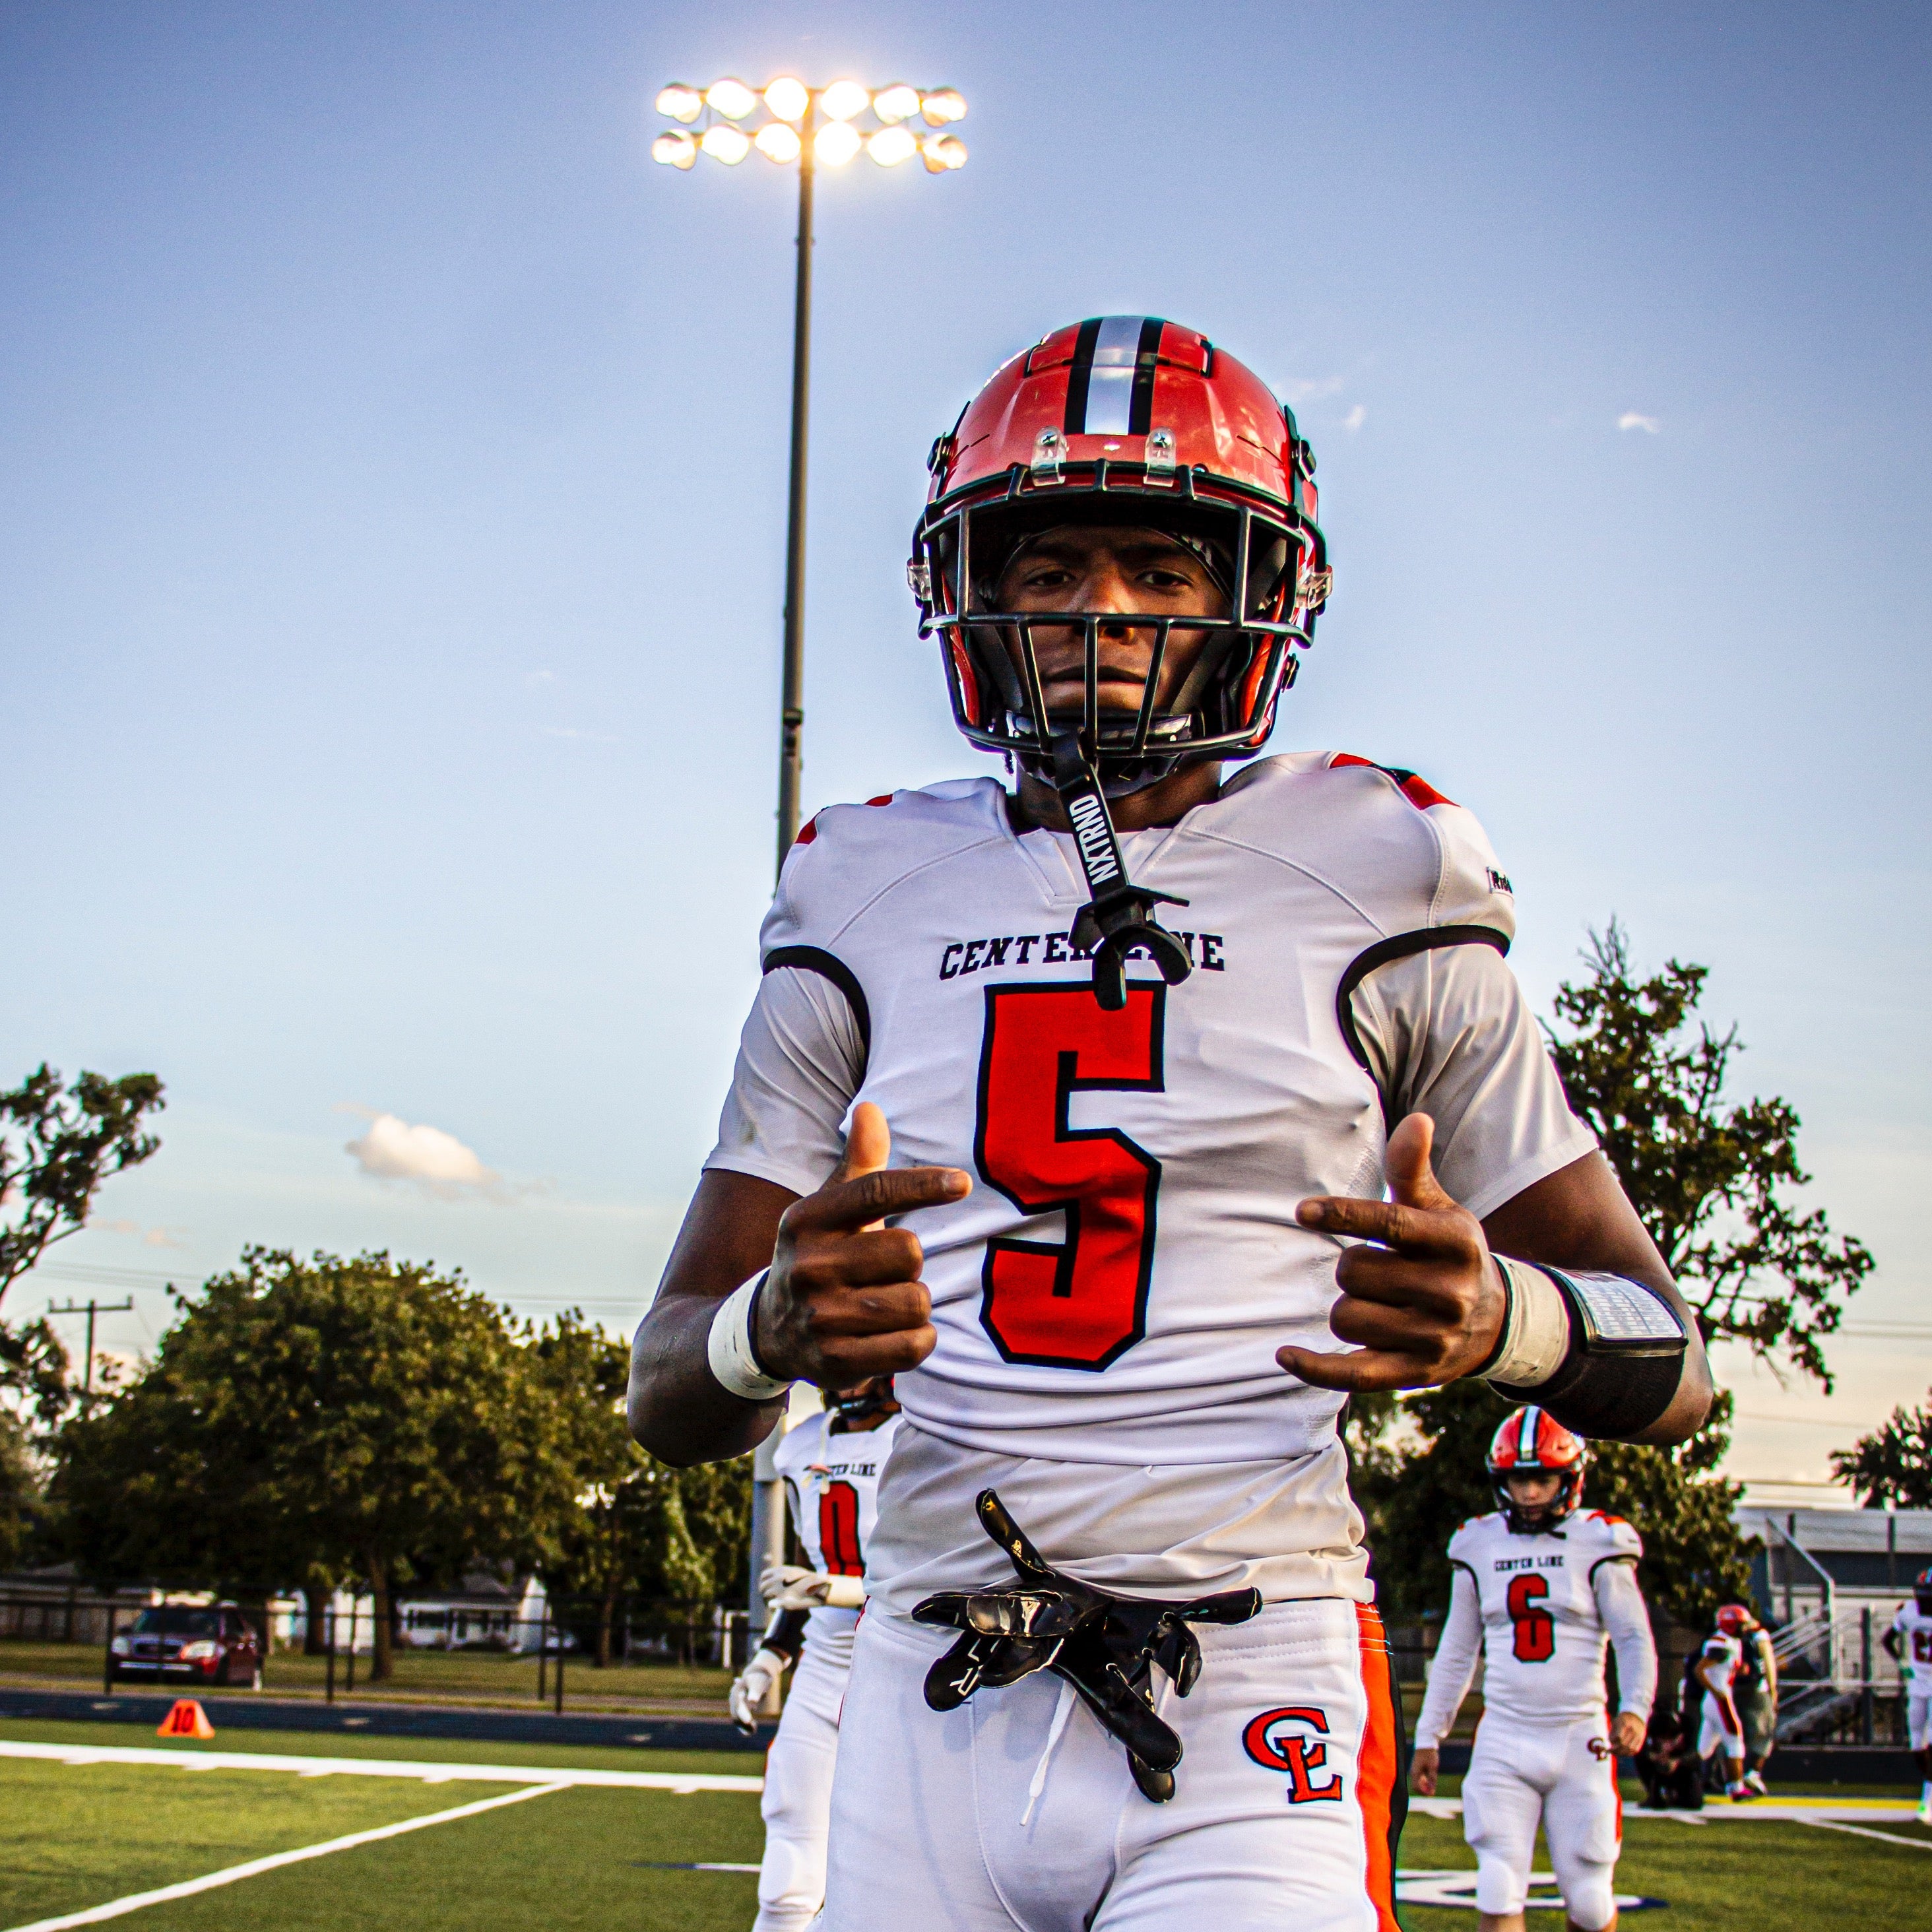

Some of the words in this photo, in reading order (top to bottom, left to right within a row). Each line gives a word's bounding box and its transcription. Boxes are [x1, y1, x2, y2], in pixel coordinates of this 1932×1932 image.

[1069, 794, 1120, 886] NXTRND
[973, 979, 1167, 1373] 5
[1507, 1572, 1555, 1663] 6
[170, 1706, 195, 1733] 10
[1241, 1706, 1343, 1805] CL
